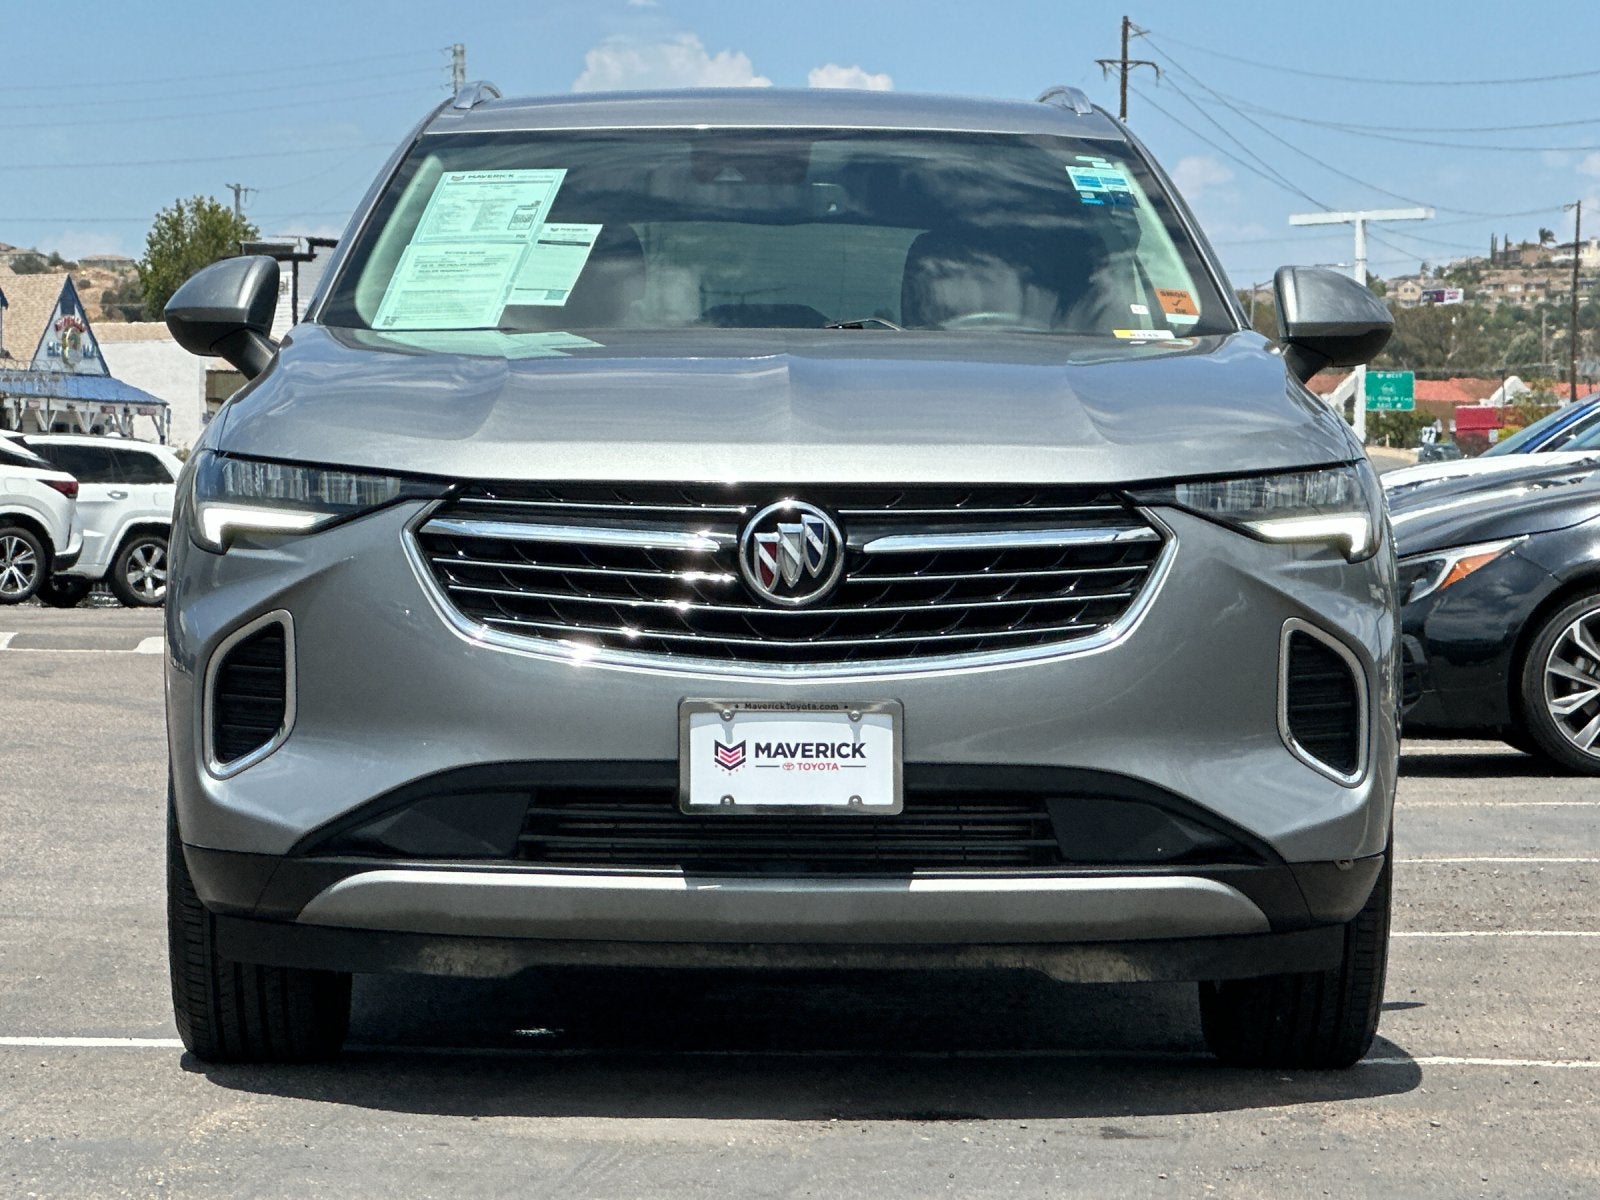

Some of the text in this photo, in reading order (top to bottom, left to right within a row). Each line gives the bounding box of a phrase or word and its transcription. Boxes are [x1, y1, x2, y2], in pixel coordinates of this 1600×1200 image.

[745, 703, 839, 711] MaverickToyota.com
[755, 742, 867, 759] MAVERICK
[797, 762, 839, 771] TOYOTA
